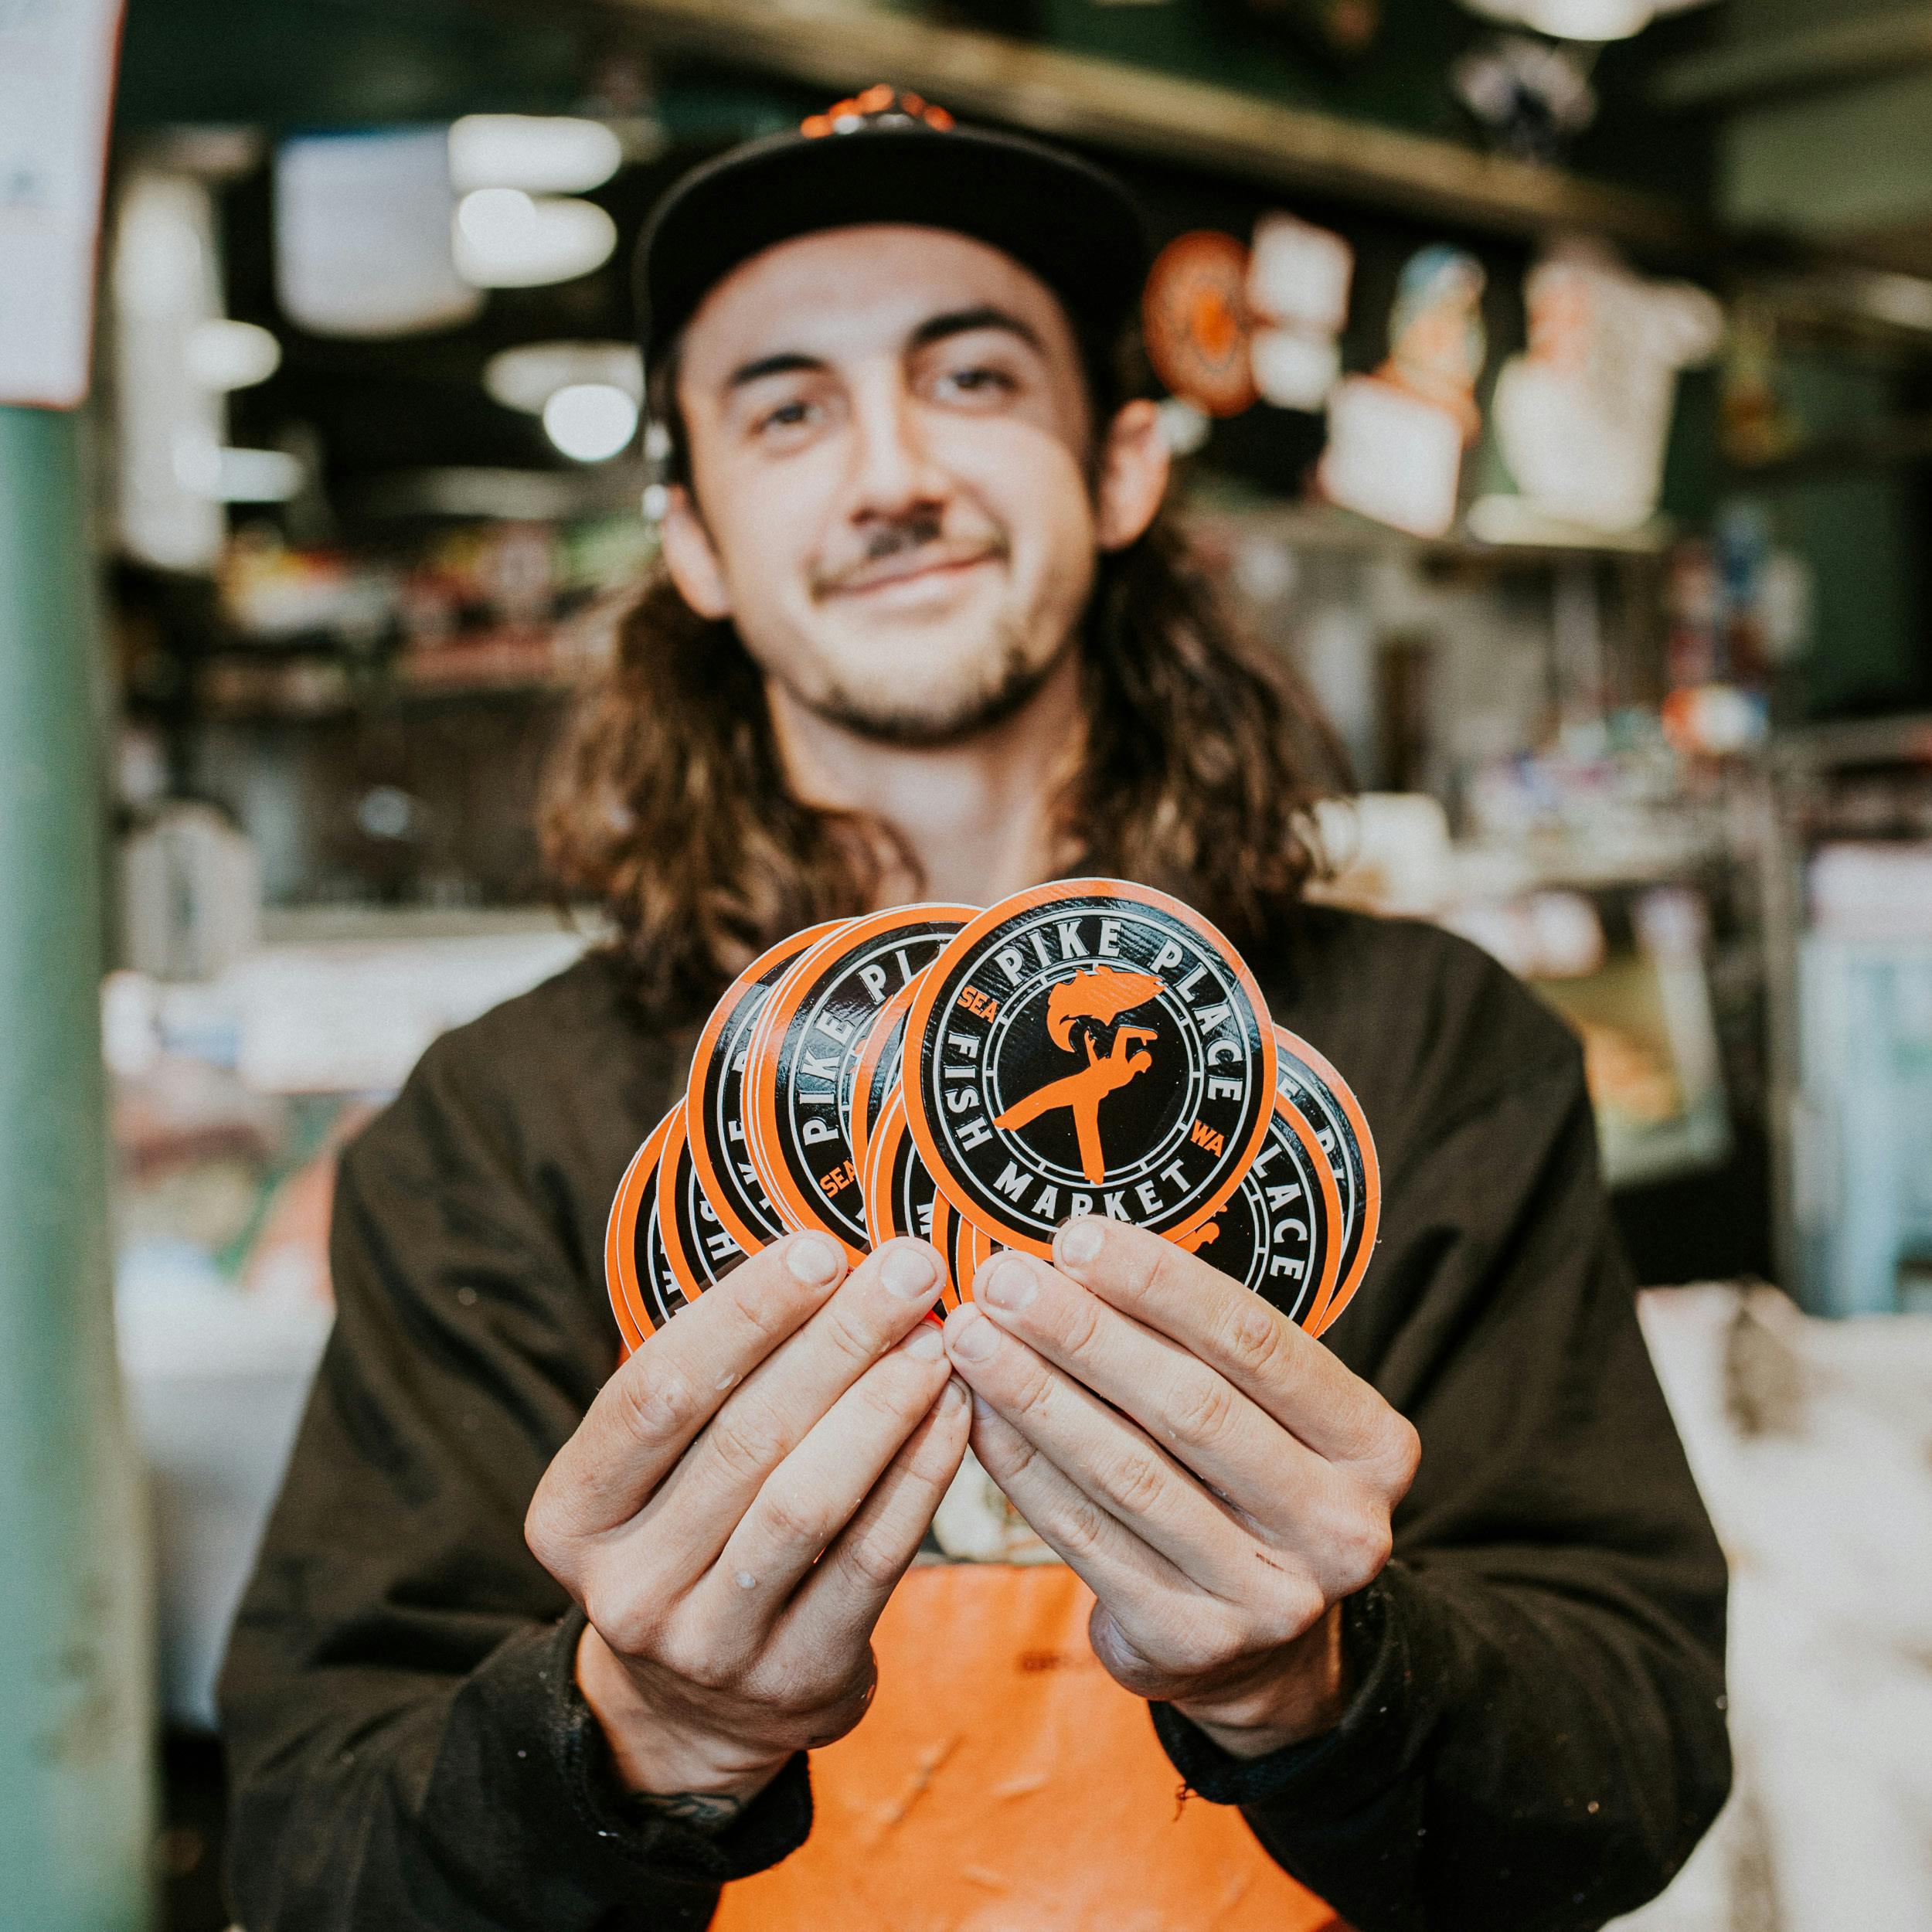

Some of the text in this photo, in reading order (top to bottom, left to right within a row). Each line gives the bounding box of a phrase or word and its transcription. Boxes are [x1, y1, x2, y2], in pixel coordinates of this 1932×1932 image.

[957, 986, 998, 1023] SEA
[994, 919, 1122, 985] PIKE
[1151, 940, 1243, 1101] PLACE
[799, 1012, 853, 1145] PIKE
[945, 1033, 1192, 1222] FISH MARKET
[1191, 1121, 1225, 1157] WA
[820, 1160, 855, 1198] SEA
[1253, 1144, 1307, 1279] LACE
